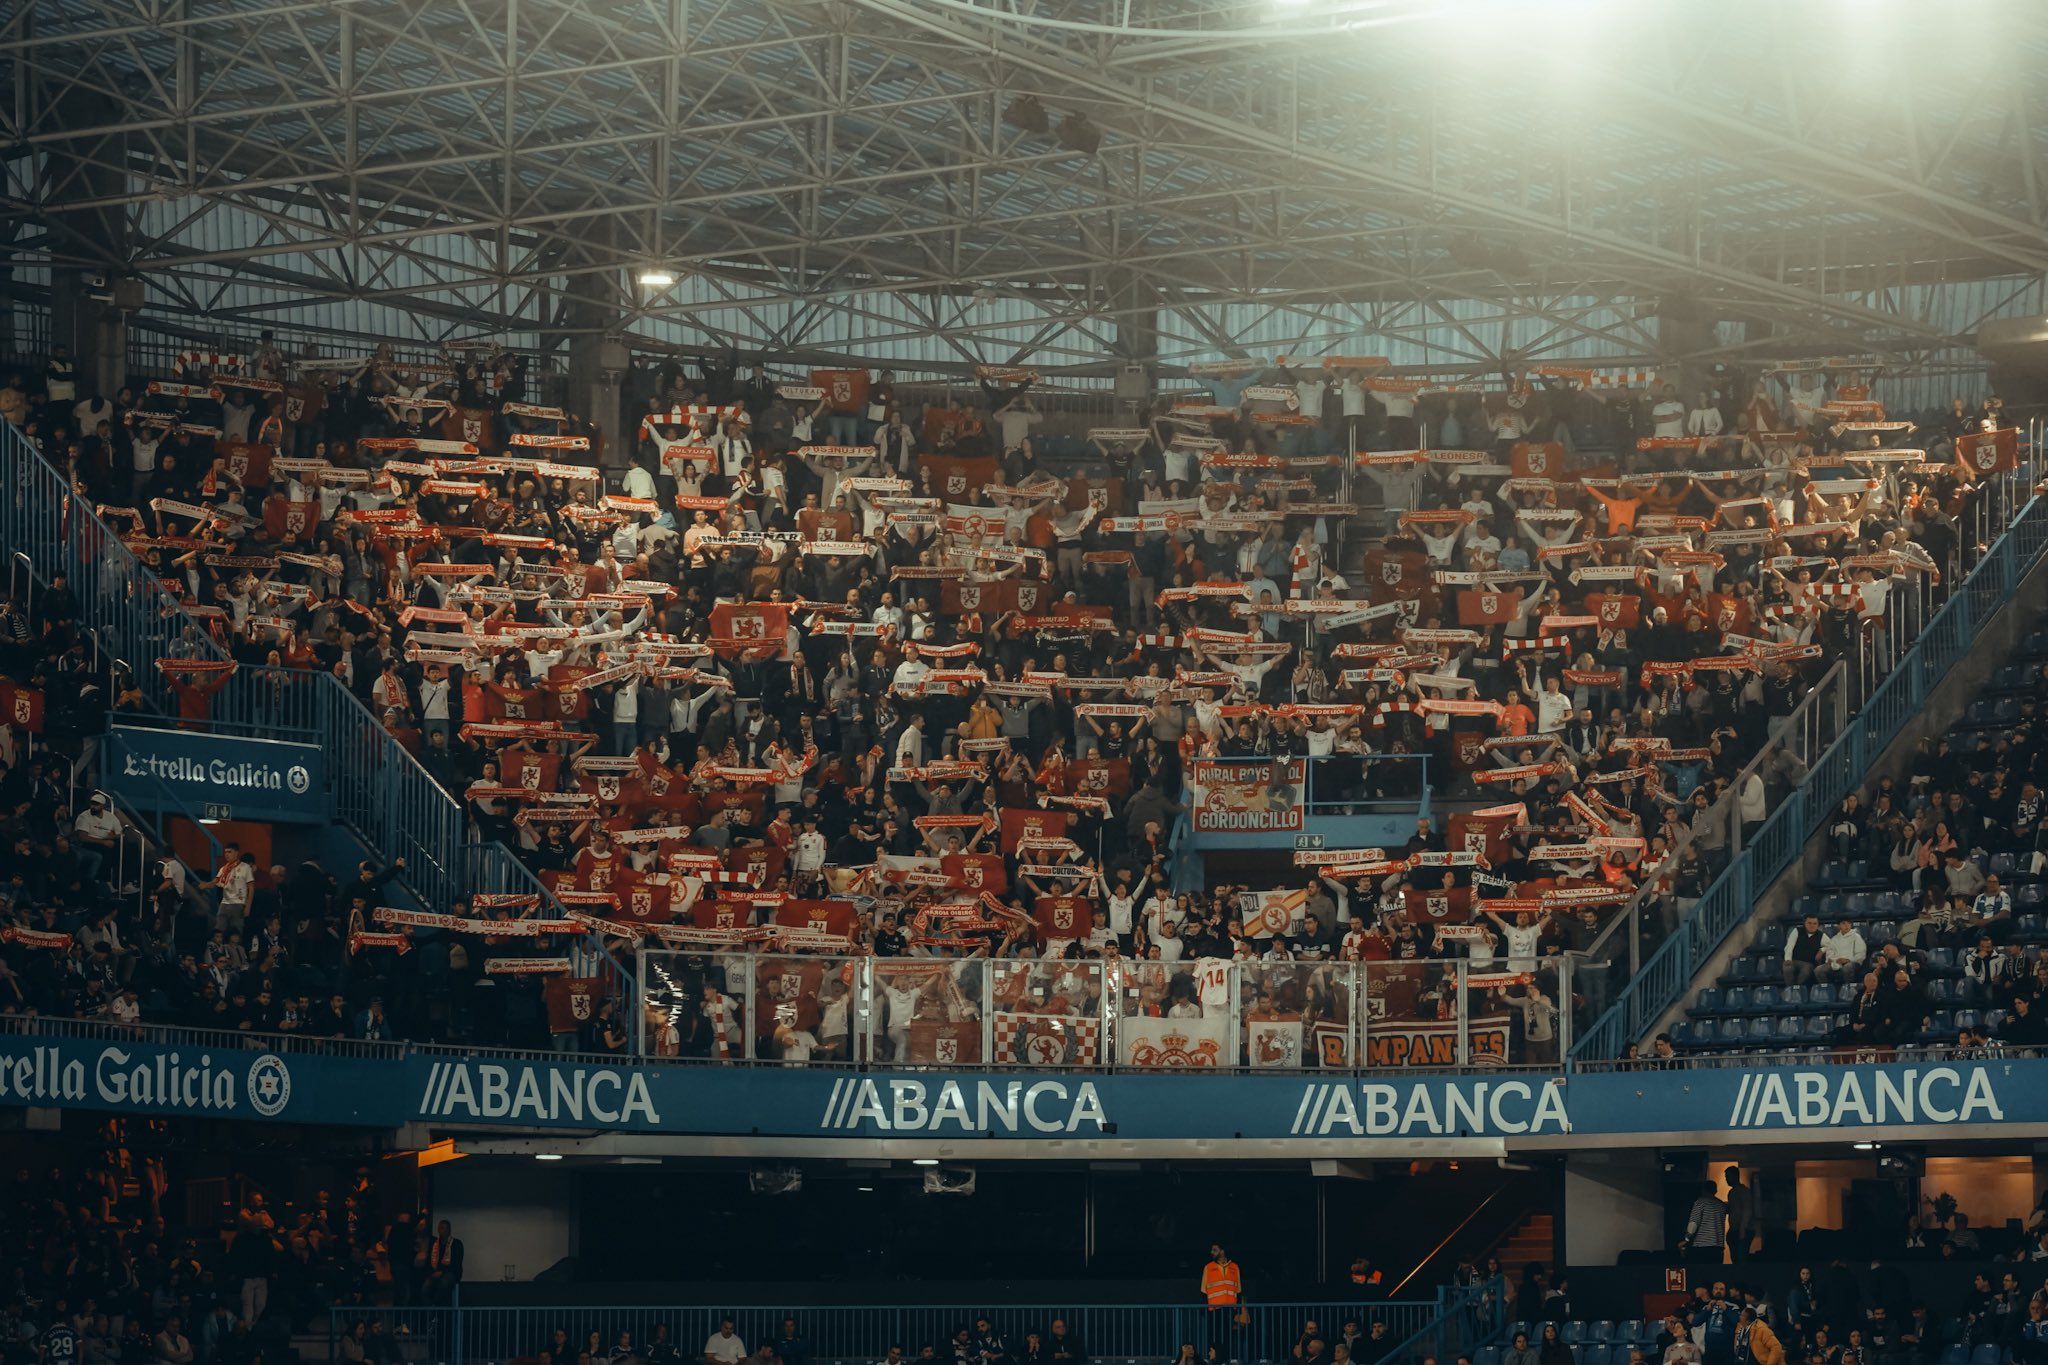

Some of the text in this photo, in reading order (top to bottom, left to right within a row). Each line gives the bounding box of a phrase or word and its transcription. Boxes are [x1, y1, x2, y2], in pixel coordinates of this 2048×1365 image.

[209, 759, 282, 790] Galicia
[1199, 768, 1239, 782] RURAL
[635, 828, 667, 836] CULTURAL
[1199, 811, 1298, 829] GORDONCILLO
[1206, 968, 1224, 988] 14
[96, 1046, 237, 1110] Galicia
[442, 1064, 661, 1124] ABANCA
[846, 1078, 1104, 1132] ABANCA
[1320, 1079, 1572, 1136] ABANCA
[1756, 1067, 2004, 1127] ABANCA
[49, 1337, 75, 1358] 29
